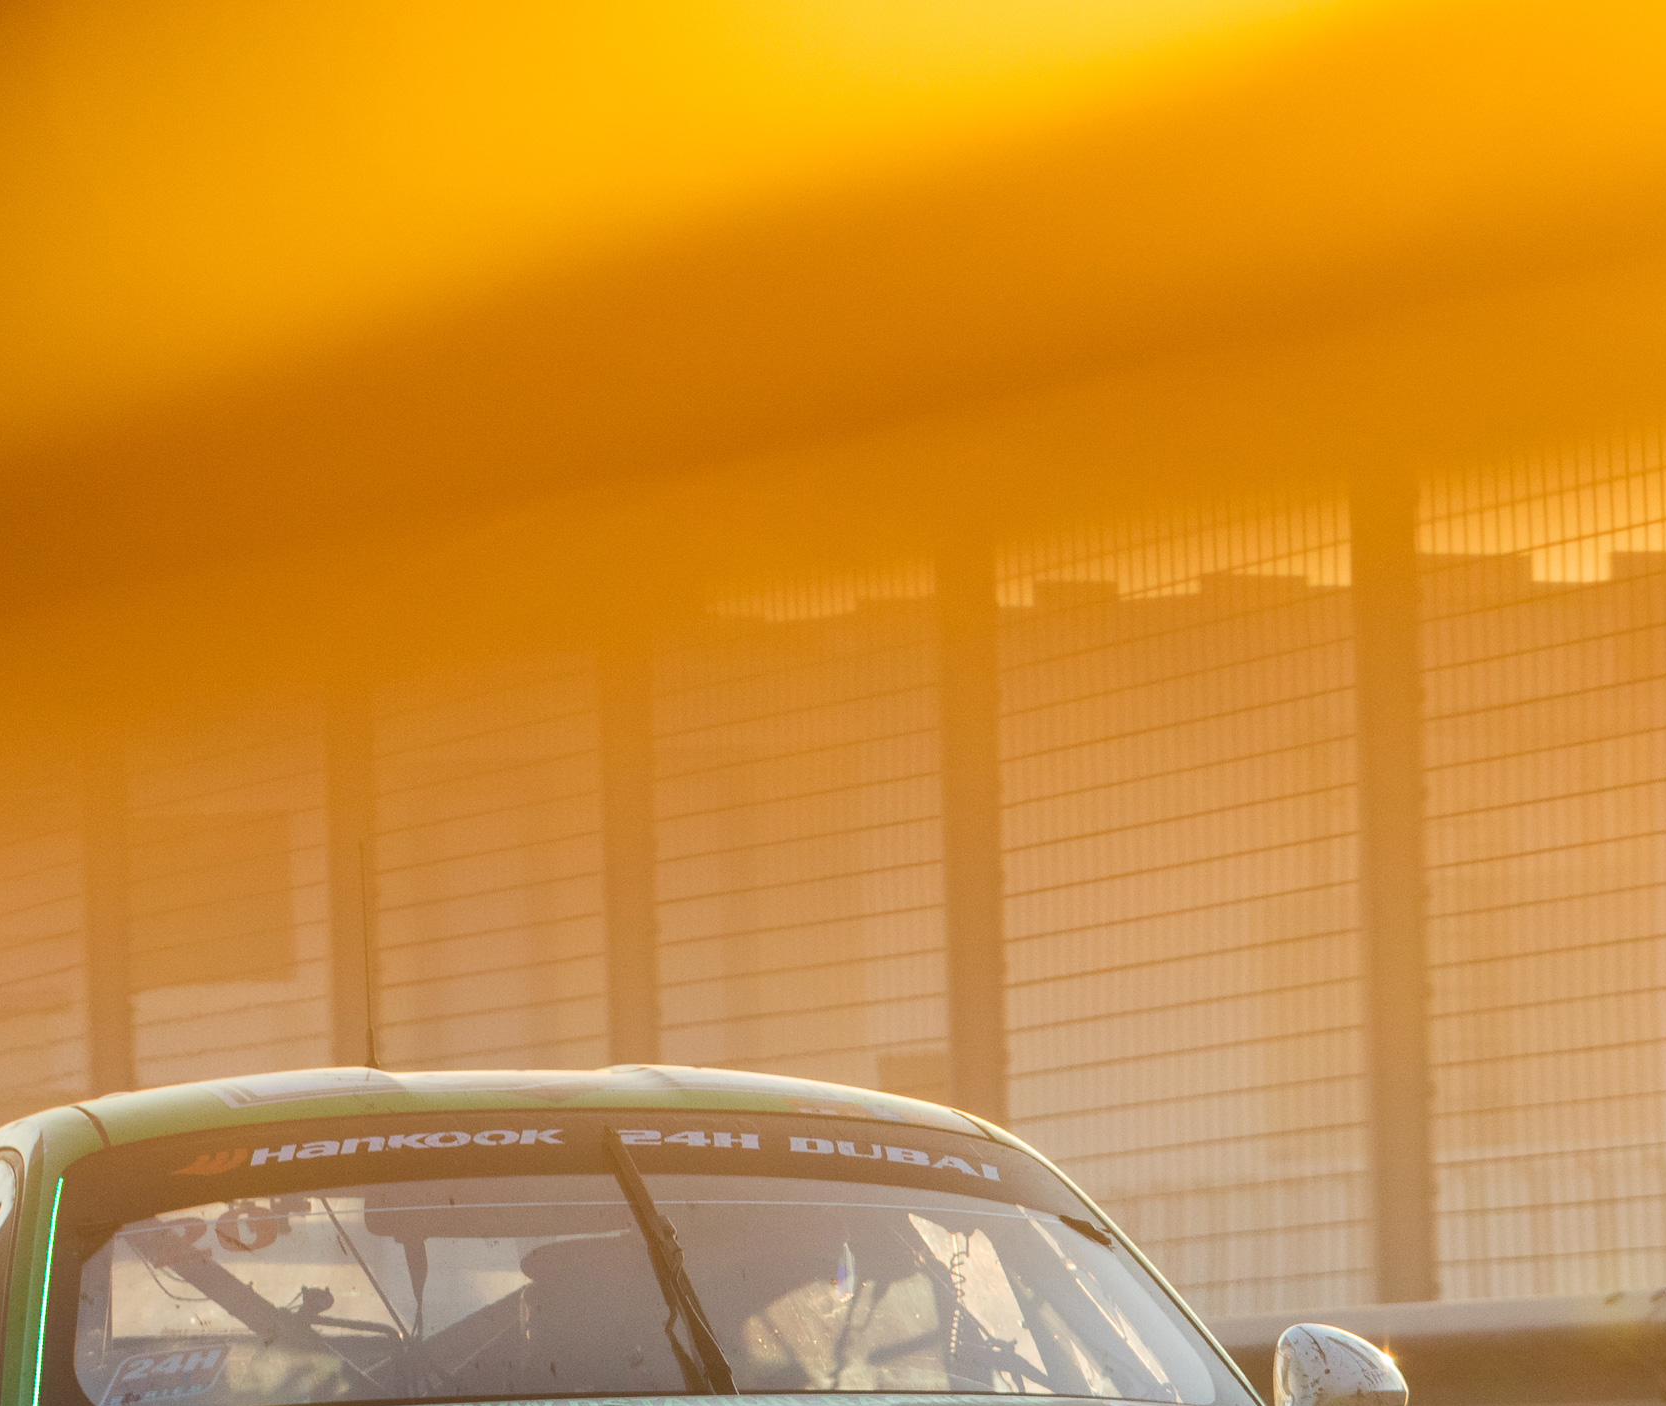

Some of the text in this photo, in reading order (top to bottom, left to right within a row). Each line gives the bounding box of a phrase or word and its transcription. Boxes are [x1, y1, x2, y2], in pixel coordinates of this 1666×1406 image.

[619, 1130, 1002, 1182] 24H DUBAI
[122, 1350, 222, 1381] 24H
